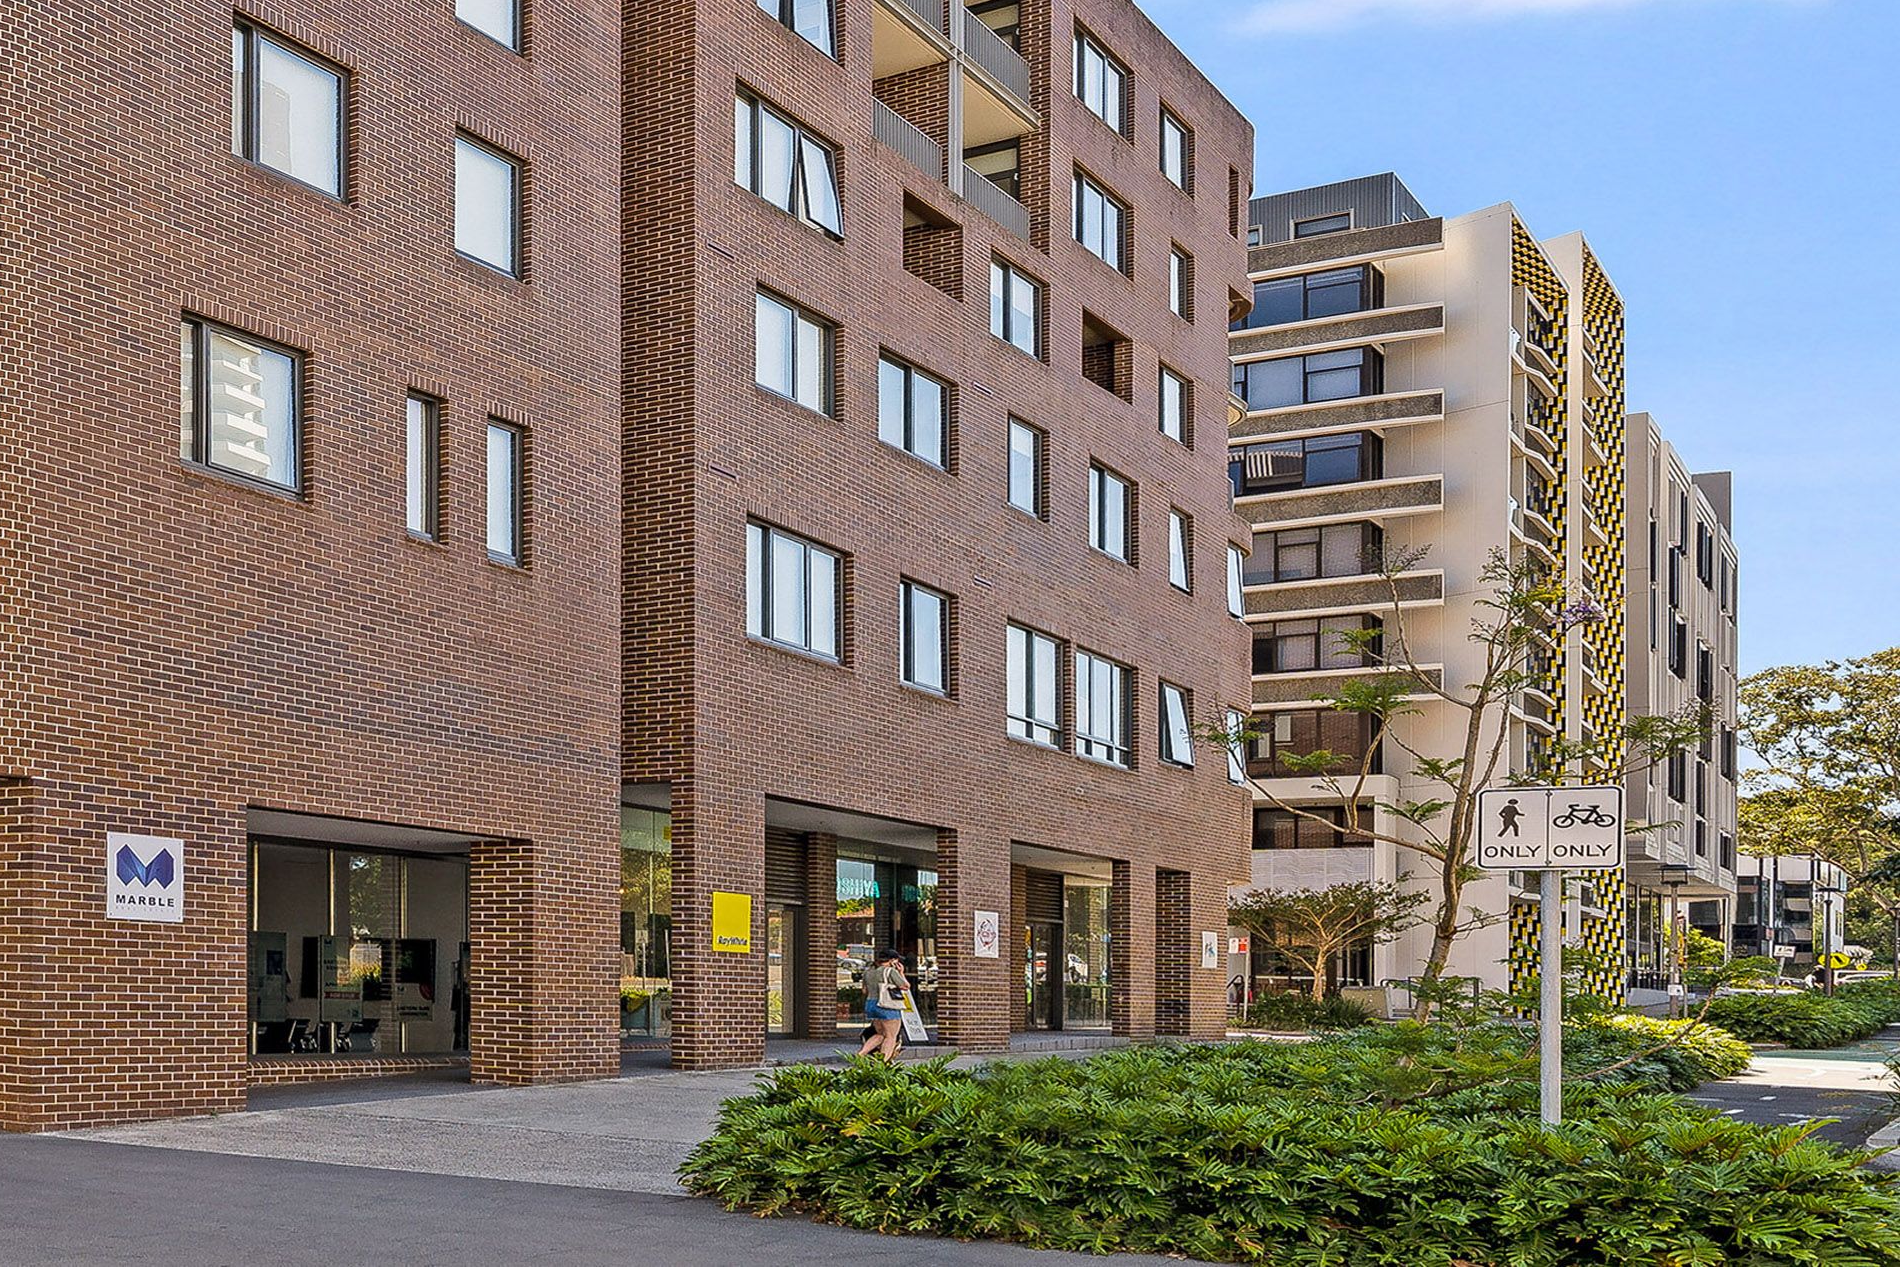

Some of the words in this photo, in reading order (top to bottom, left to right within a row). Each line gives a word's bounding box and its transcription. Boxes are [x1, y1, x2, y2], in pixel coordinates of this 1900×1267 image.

[1484, 845, 1541, 858] ONLY
[1553, 844, 1612, 857] ONLY
[837, 877, 880, 898] SHIYA
[115, 894, 174, 907] MARBLE
